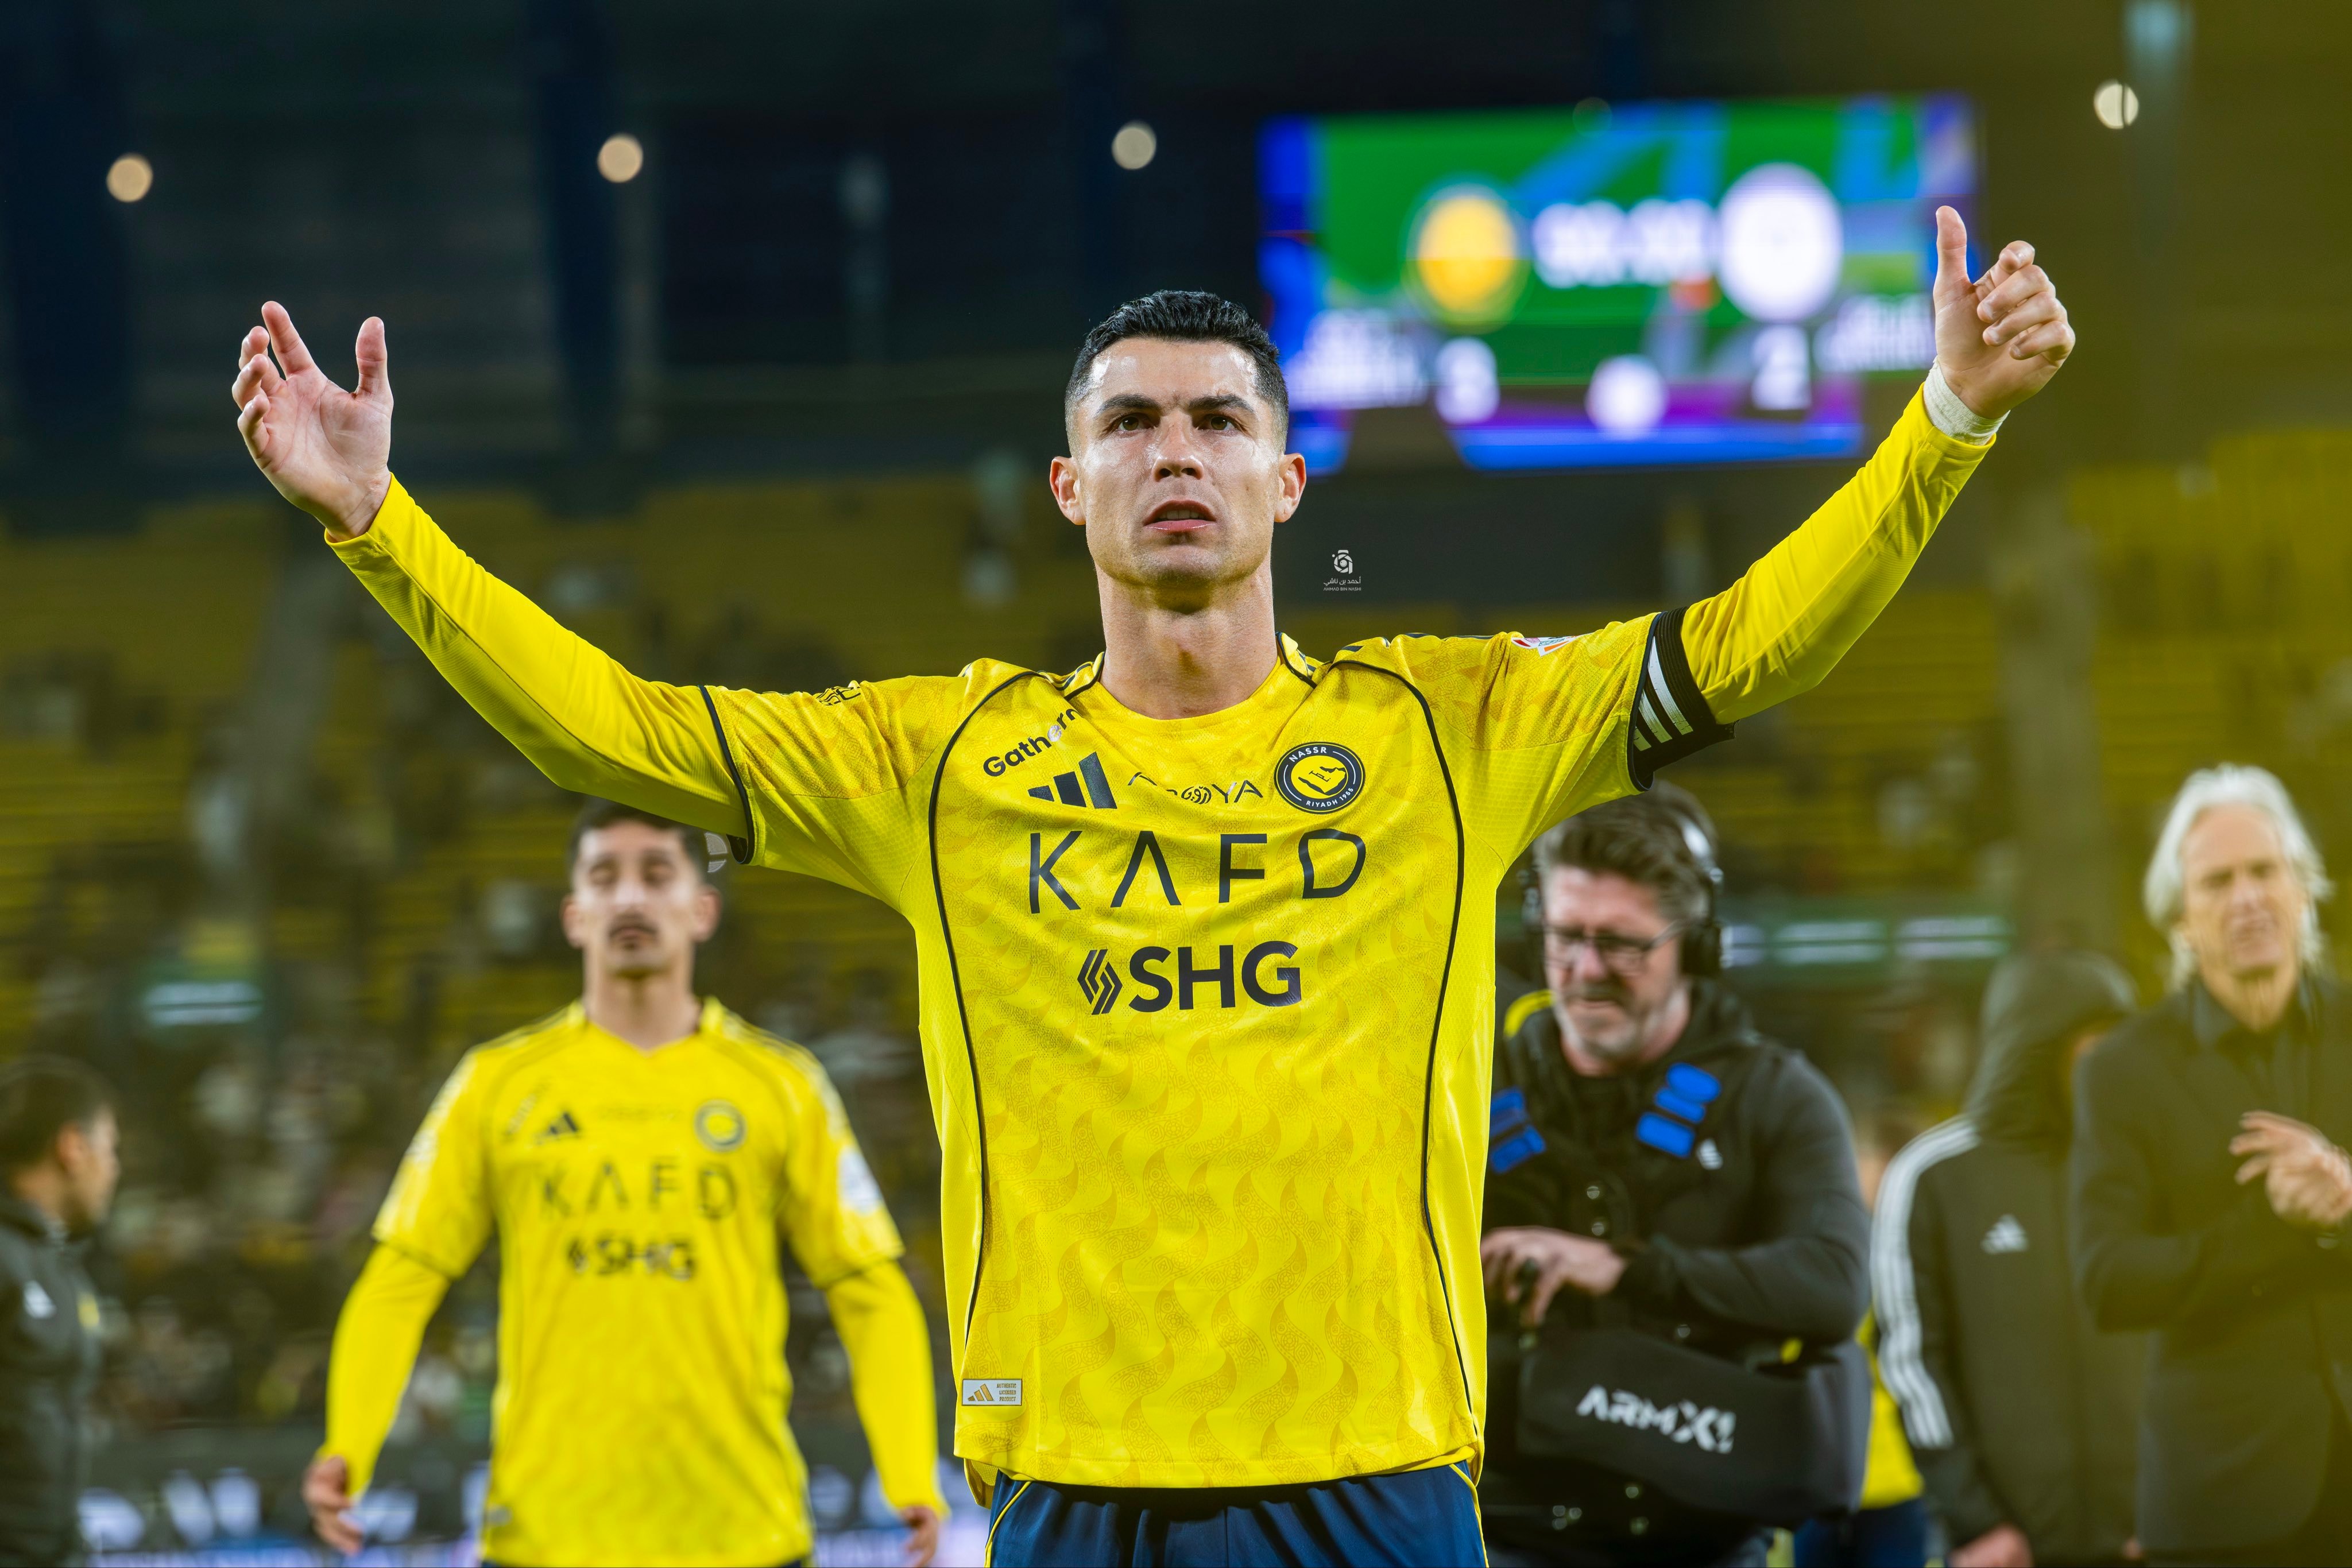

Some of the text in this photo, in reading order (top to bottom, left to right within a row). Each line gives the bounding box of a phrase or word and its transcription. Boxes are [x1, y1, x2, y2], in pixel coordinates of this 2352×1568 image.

[1289, 746, 1327, 762] NASSR
[1306, 788, 1353, 807] RIYADH 1955
[1029, 828, 1366, 915] KAFD
[1128, 940, 1302, 1011] SHG
